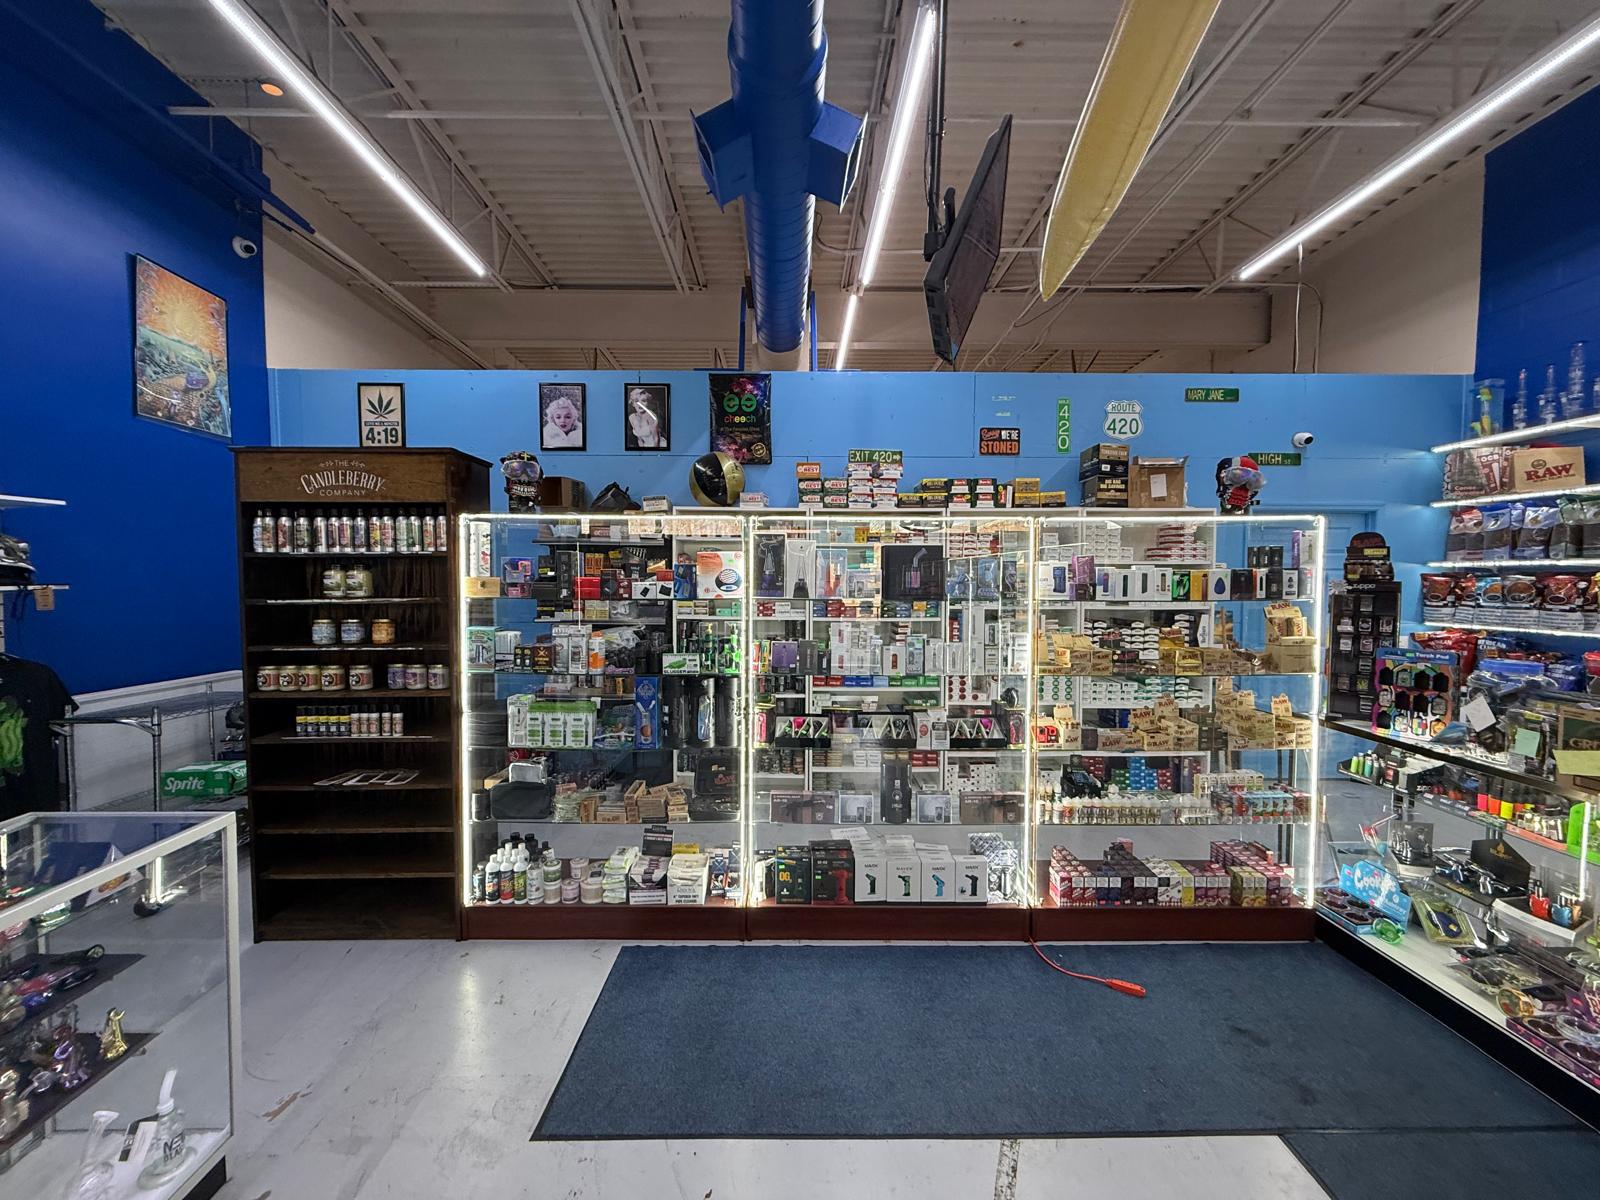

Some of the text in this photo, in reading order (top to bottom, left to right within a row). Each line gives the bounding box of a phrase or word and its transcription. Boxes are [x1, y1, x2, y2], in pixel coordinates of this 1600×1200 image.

[1187, 389, 1225, 401] MARY JANE
[1111, 403, 1137, 412] ROUTE
[724, 414, 756, 423] cheech
[1058, 404, 1069, 450] 420
[1106, 418, 1140, 435] 420
[365, 427, 399, 444] 4:19
[980, 441, 1019, 454] STONED
[849, 451, 892, 462] EXIT 420
[1257, 453, 1282, 464] HIGH
[1480, 453, 1500, 462] OCB
[1524, 462, 1575, 481] RAW
[300, 469, 386, 494] CANDLEBERRY
[320, 489, 366, 497] COMPANY
[1271, 602, 1291, 610] RAW
[1133, 710, 1151, 719] RAW
[1065, 736, 1079, 744] RAW
[1102, 739, 1121, 748] RAW
[1151, 739, 1169, 747] RAW
[164, 776, 206, 793] Sprite
